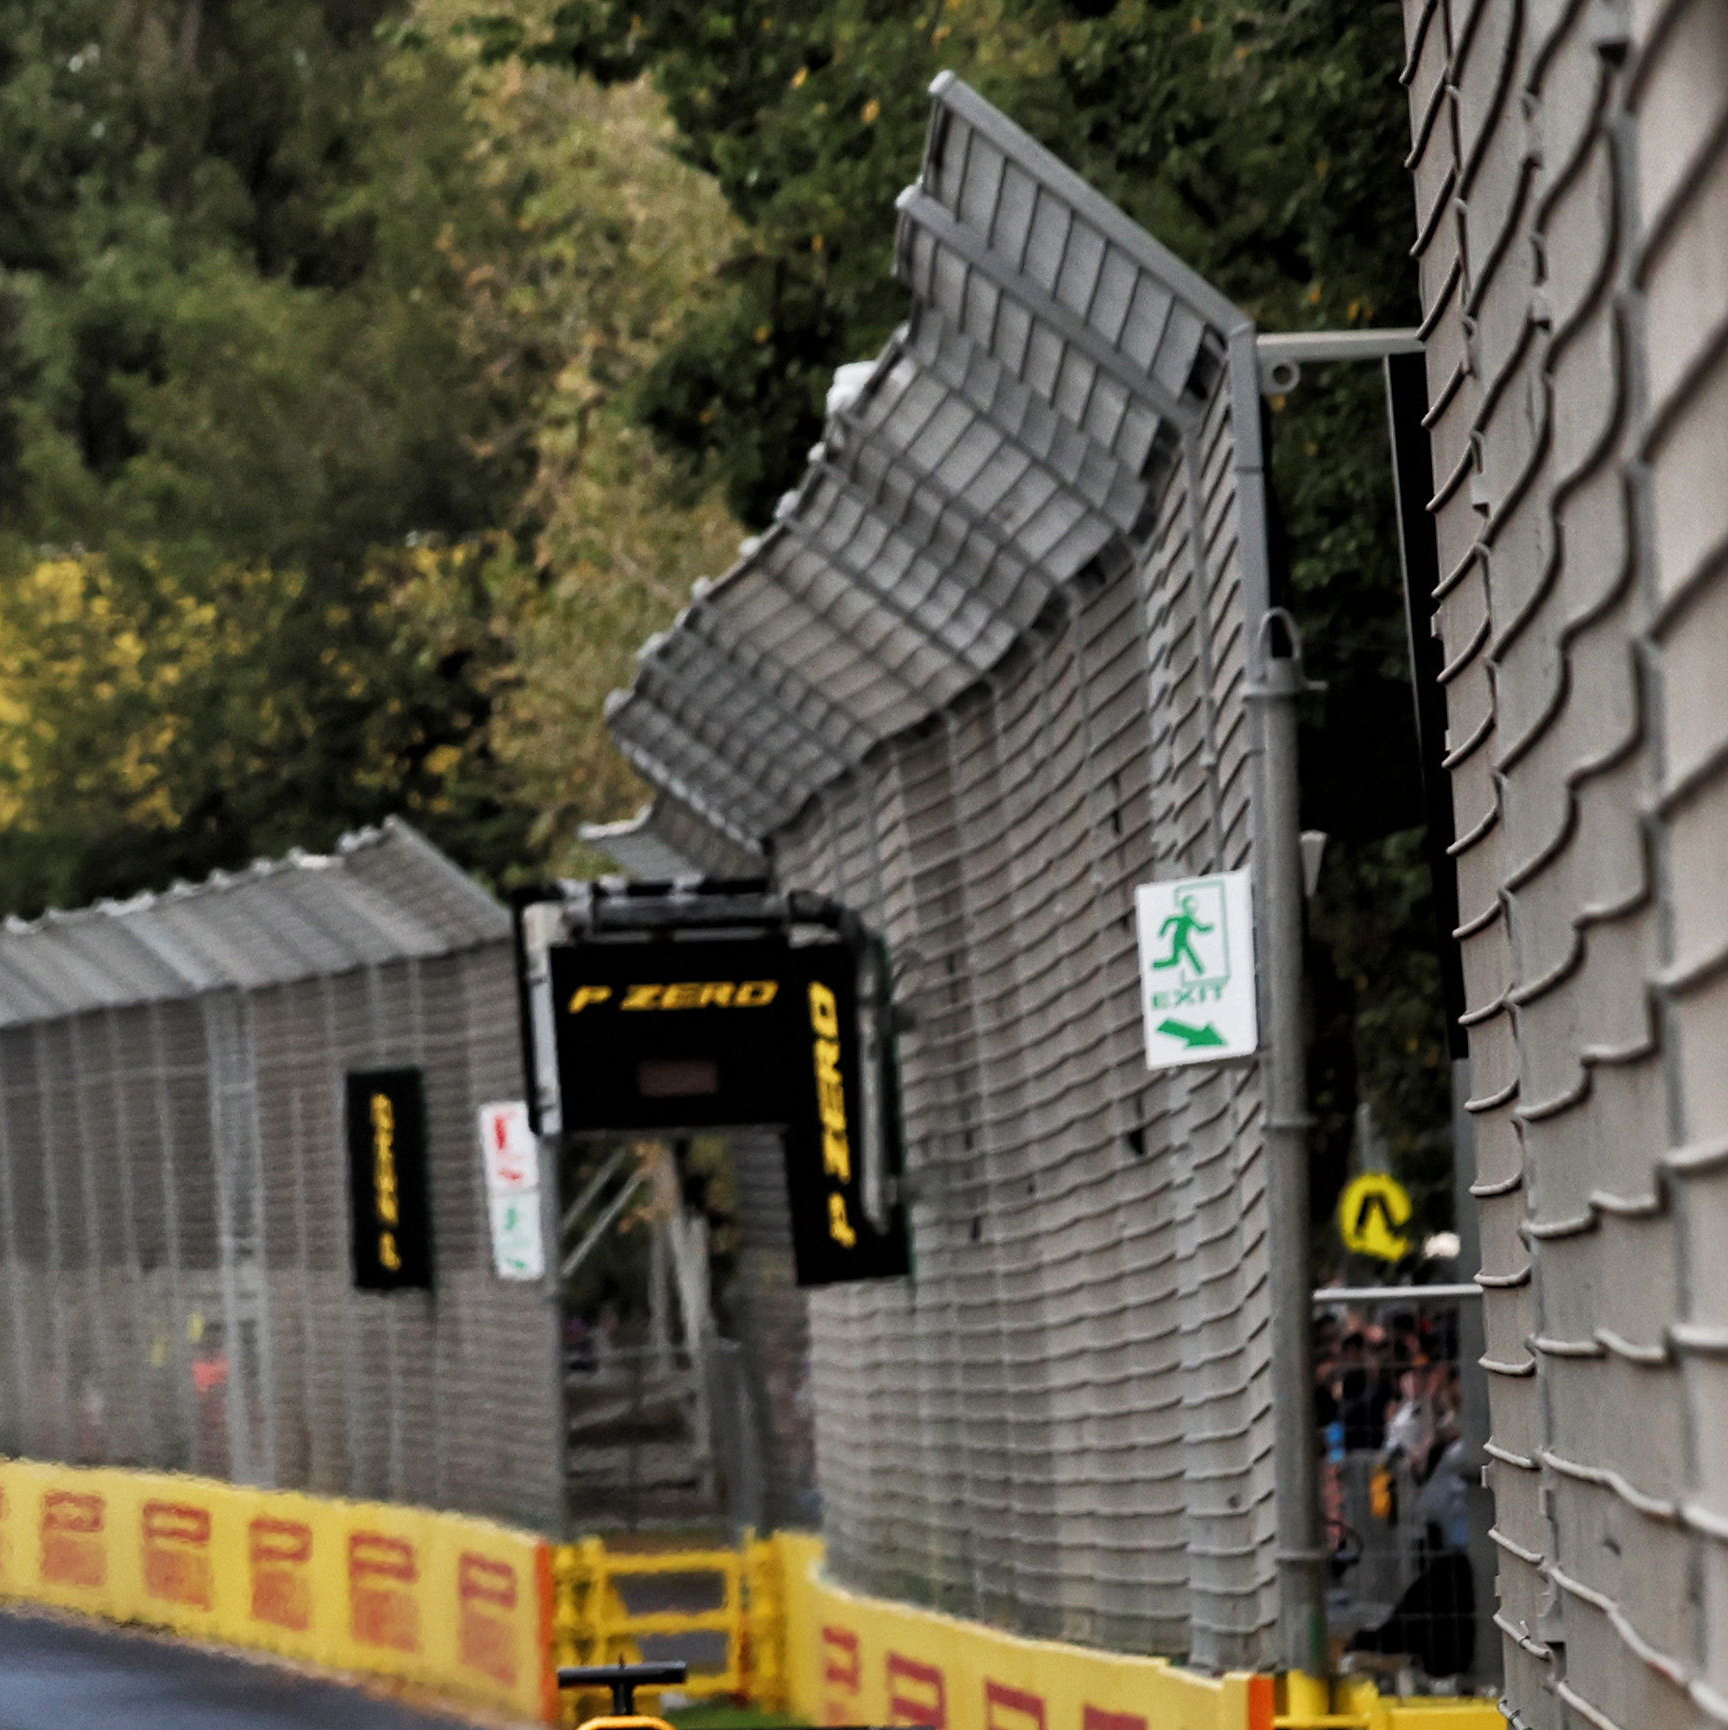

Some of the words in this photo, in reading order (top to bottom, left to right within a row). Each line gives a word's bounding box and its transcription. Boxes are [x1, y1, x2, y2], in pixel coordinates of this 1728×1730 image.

[568, 986, 612, 1014] P
[620, 980, 779, 1010] ZERO
[1151, 984, 1223, 1010] EXIT
